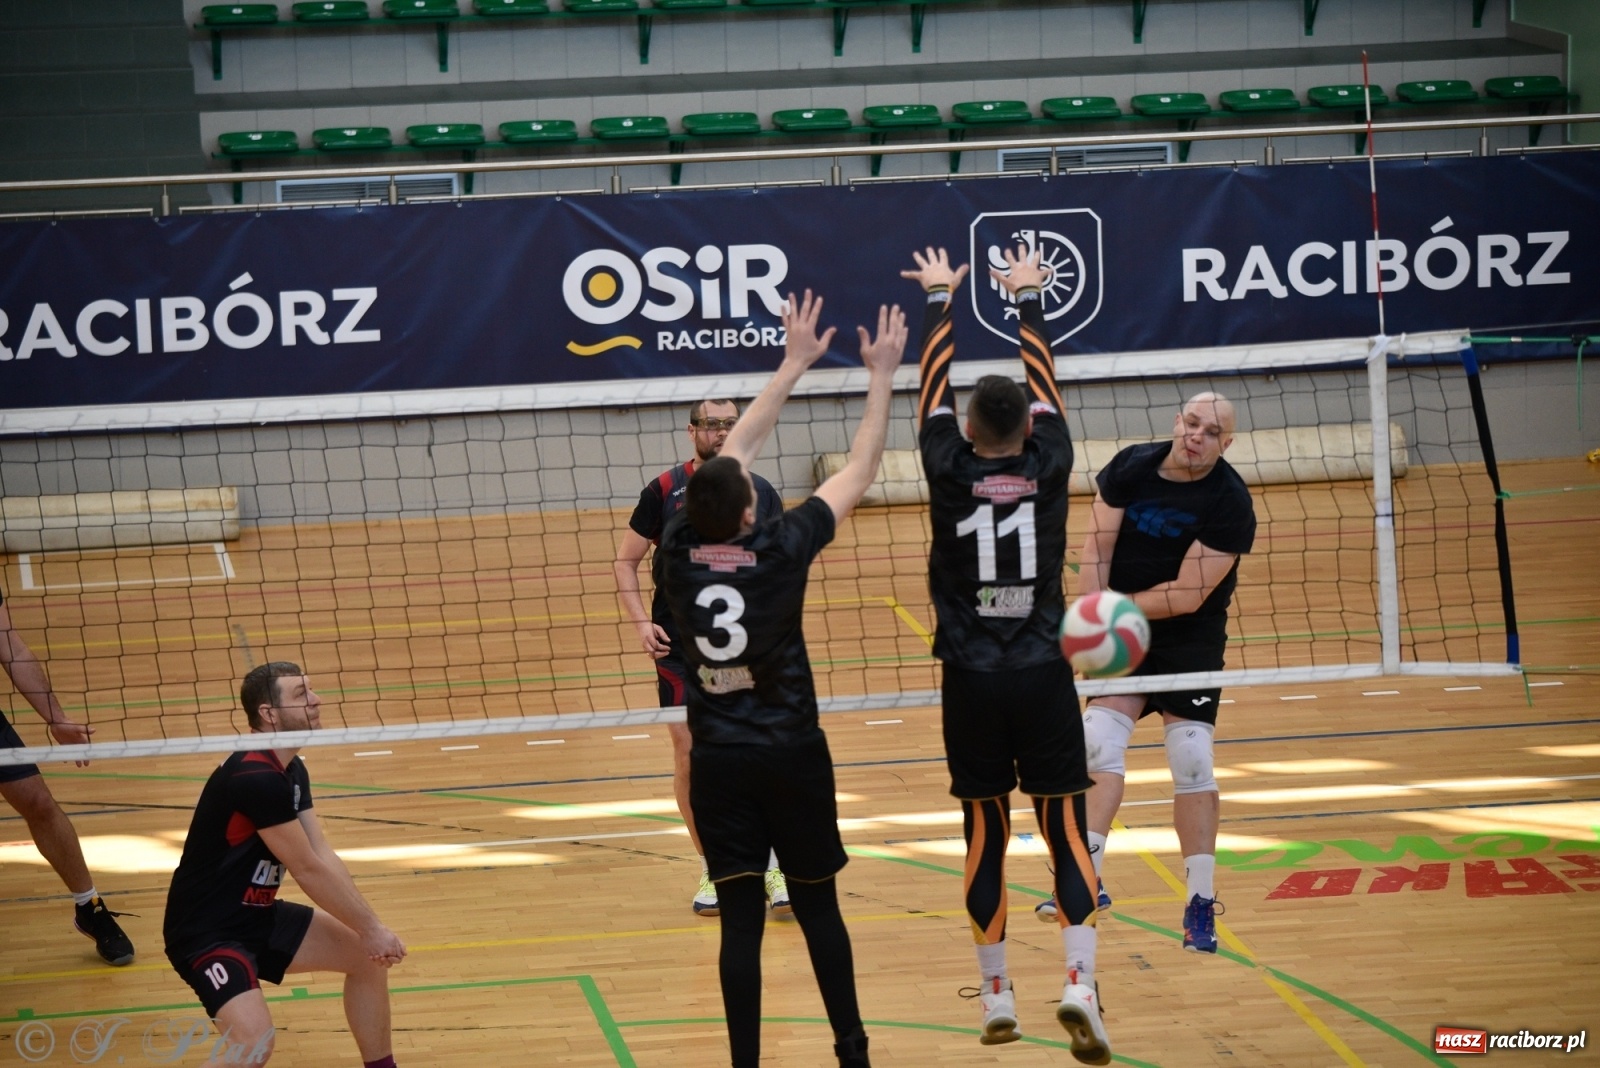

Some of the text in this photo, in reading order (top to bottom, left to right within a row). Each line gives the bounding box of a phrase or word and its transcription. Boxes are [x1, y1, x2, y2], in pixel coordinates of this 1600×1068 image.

[562, 243, 791, 325] OSiR
[1182, 215, 1571, 302] RACIBÓRZ
[0, 271, 381, 361] ACIBÓRZ
[694, 551, 752, 564] PIWIARNIA
[956, 502, 1037, 581] 11
[694, 584, 748, 661] 3
[204, 962, 229, 991] 10
